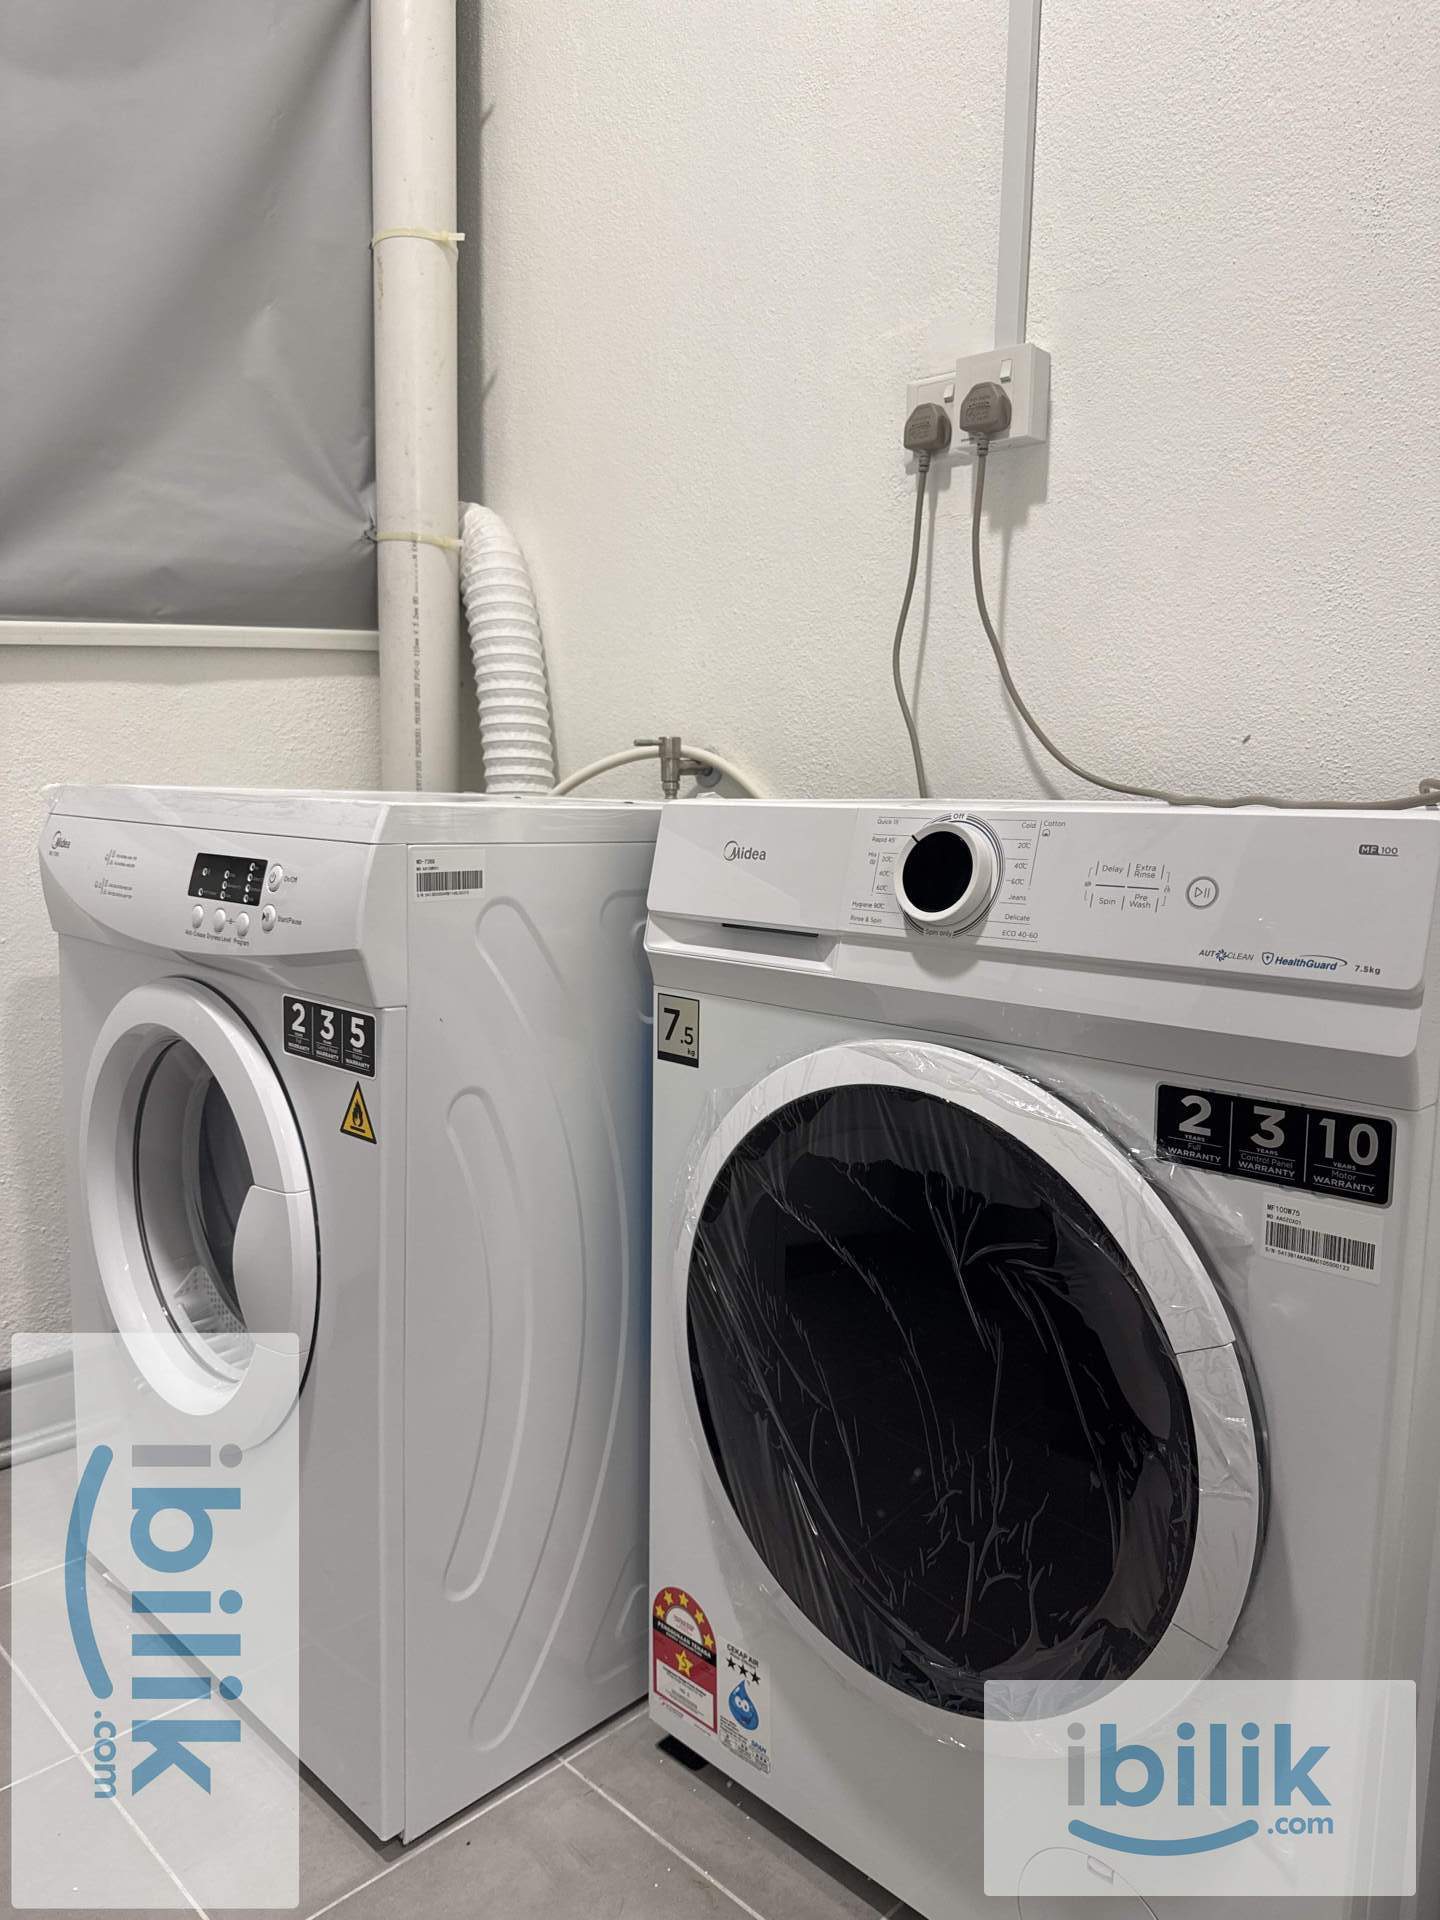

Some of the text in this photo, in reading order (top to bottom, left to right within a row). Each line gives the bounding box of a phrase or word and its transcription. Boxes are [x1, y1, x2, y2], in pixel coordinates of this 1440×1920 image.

[1044, 820, 1066, 828] Cotton
[723, 840, 766, 861] Midea
[1360, 845, 1399, 855] MF 100
[1102, 864, 1157, 874] Delay Extra
[1134, 871, 1156, 879] Rinse
[1008, 894, 1026, 902] Jeans
[1099, 897, 1151, 909] Spin Wash
[1004, 913, 1030, 922] Delicate
[925, 929, 952, 938] Spin only
[1002, 930, 1038, 939] ECO 40-60
[1274, 956, 1337, 971] HealthGuard
[1354, 965, 1381, 976] 7.5kg
[291, 1002, 306, 1033] 2
[320, 1009, 335, 1040] 3
[350, 1016, 365, 1048] 5
[1178, 1095, 1211, 1136] 2
[1250, 1105, 1286, 1149] 3
[1185, 1134, 1205, 1142] YEARS
[1318, 1118, 1379, 1166] 10
[1187, 1142, 1202, 1151] Full
[1256, 1147, 1279, 1156] YEARS
[1167, 1146, 1222, 1163] WARRANTY
[1240, 1152, 1294, 1170] Control Panel
[1332, 1161, 1357, 1171] YEARS
[1238, 1160, 1296, 1178] WARRANTY
[1331, 1169, 1357, 1181] Motor
[1313, 1175, 1375, 1193] WARRANTY
